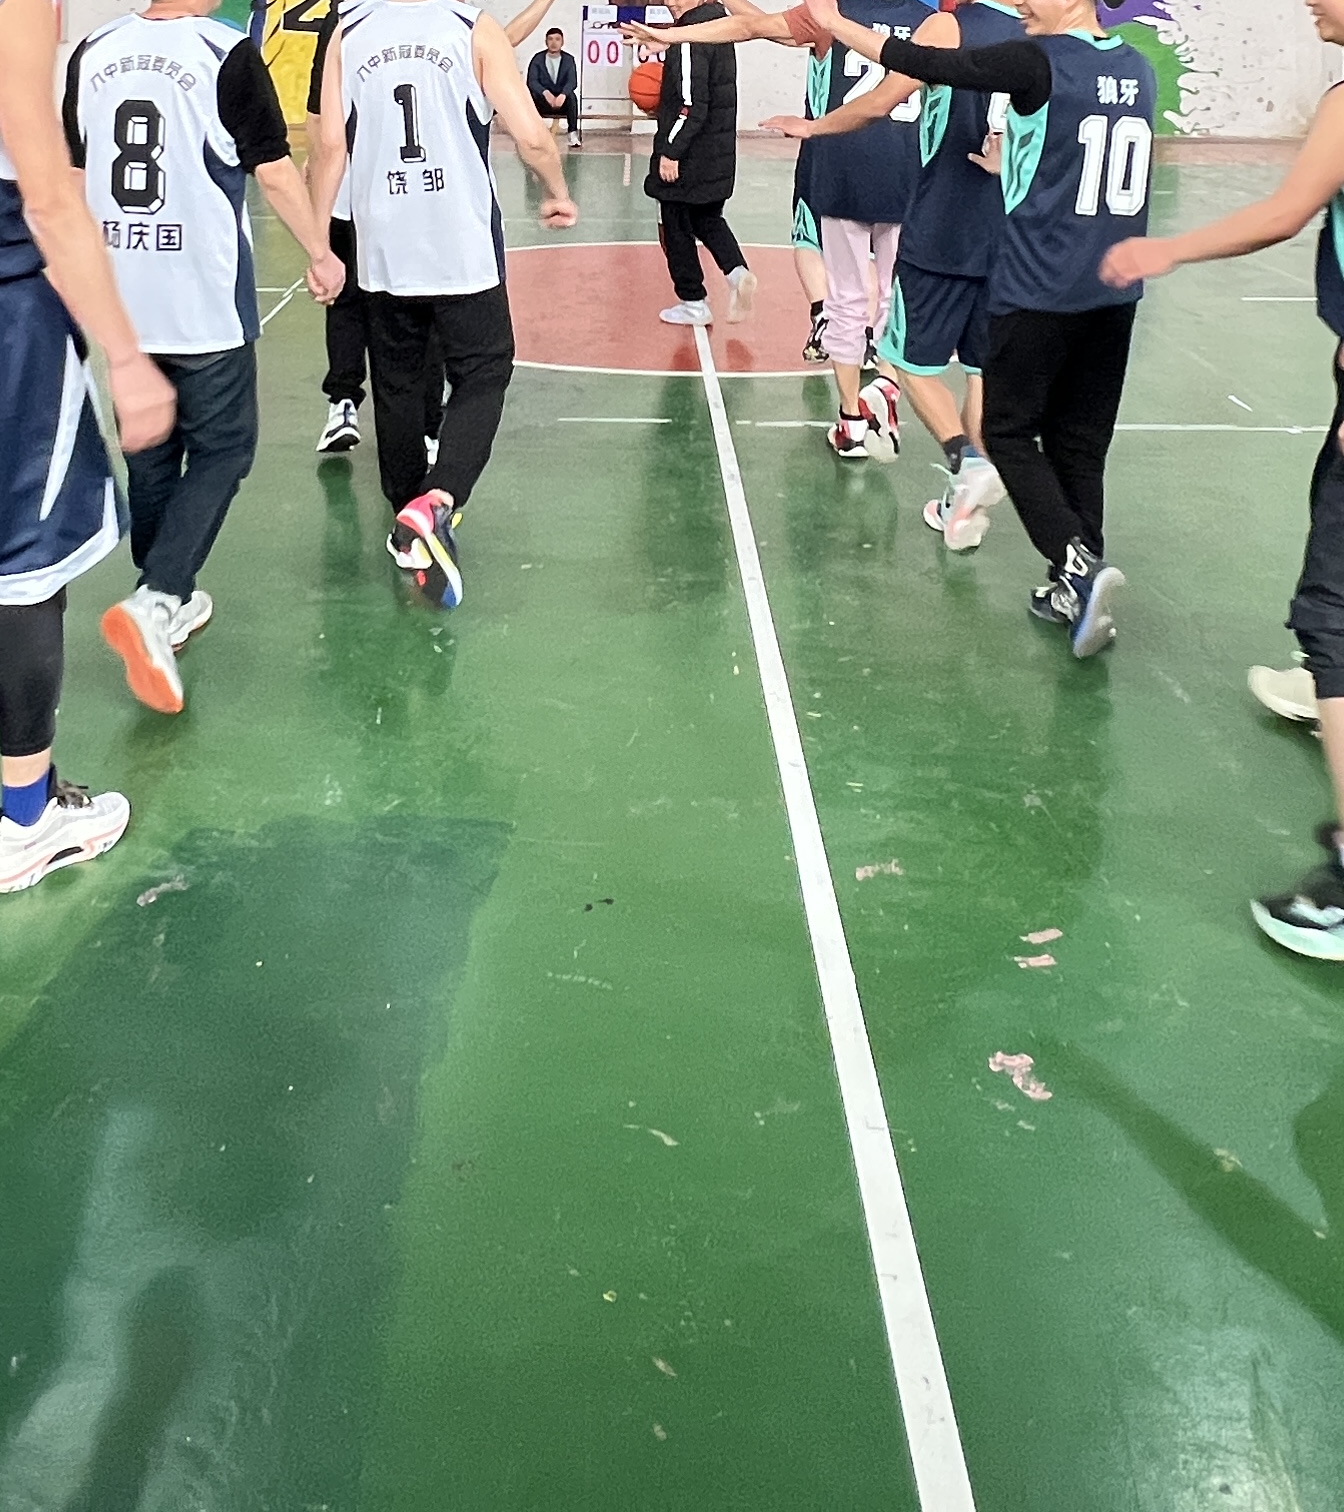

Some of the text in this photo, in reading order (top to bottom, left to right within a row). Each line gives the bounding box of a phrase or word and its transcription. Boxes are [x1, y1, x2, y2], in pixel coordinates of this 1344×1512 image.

[356, 44, 454, 83] 八中新冠委员会
[588, 40, 619, 64] 00
[1096, 75, 1140, 107] 狼牙
[393, 83, 427, 164] 1
[111, 99, 166, 216] 8
[1074, 113, 1153, 217] 10
